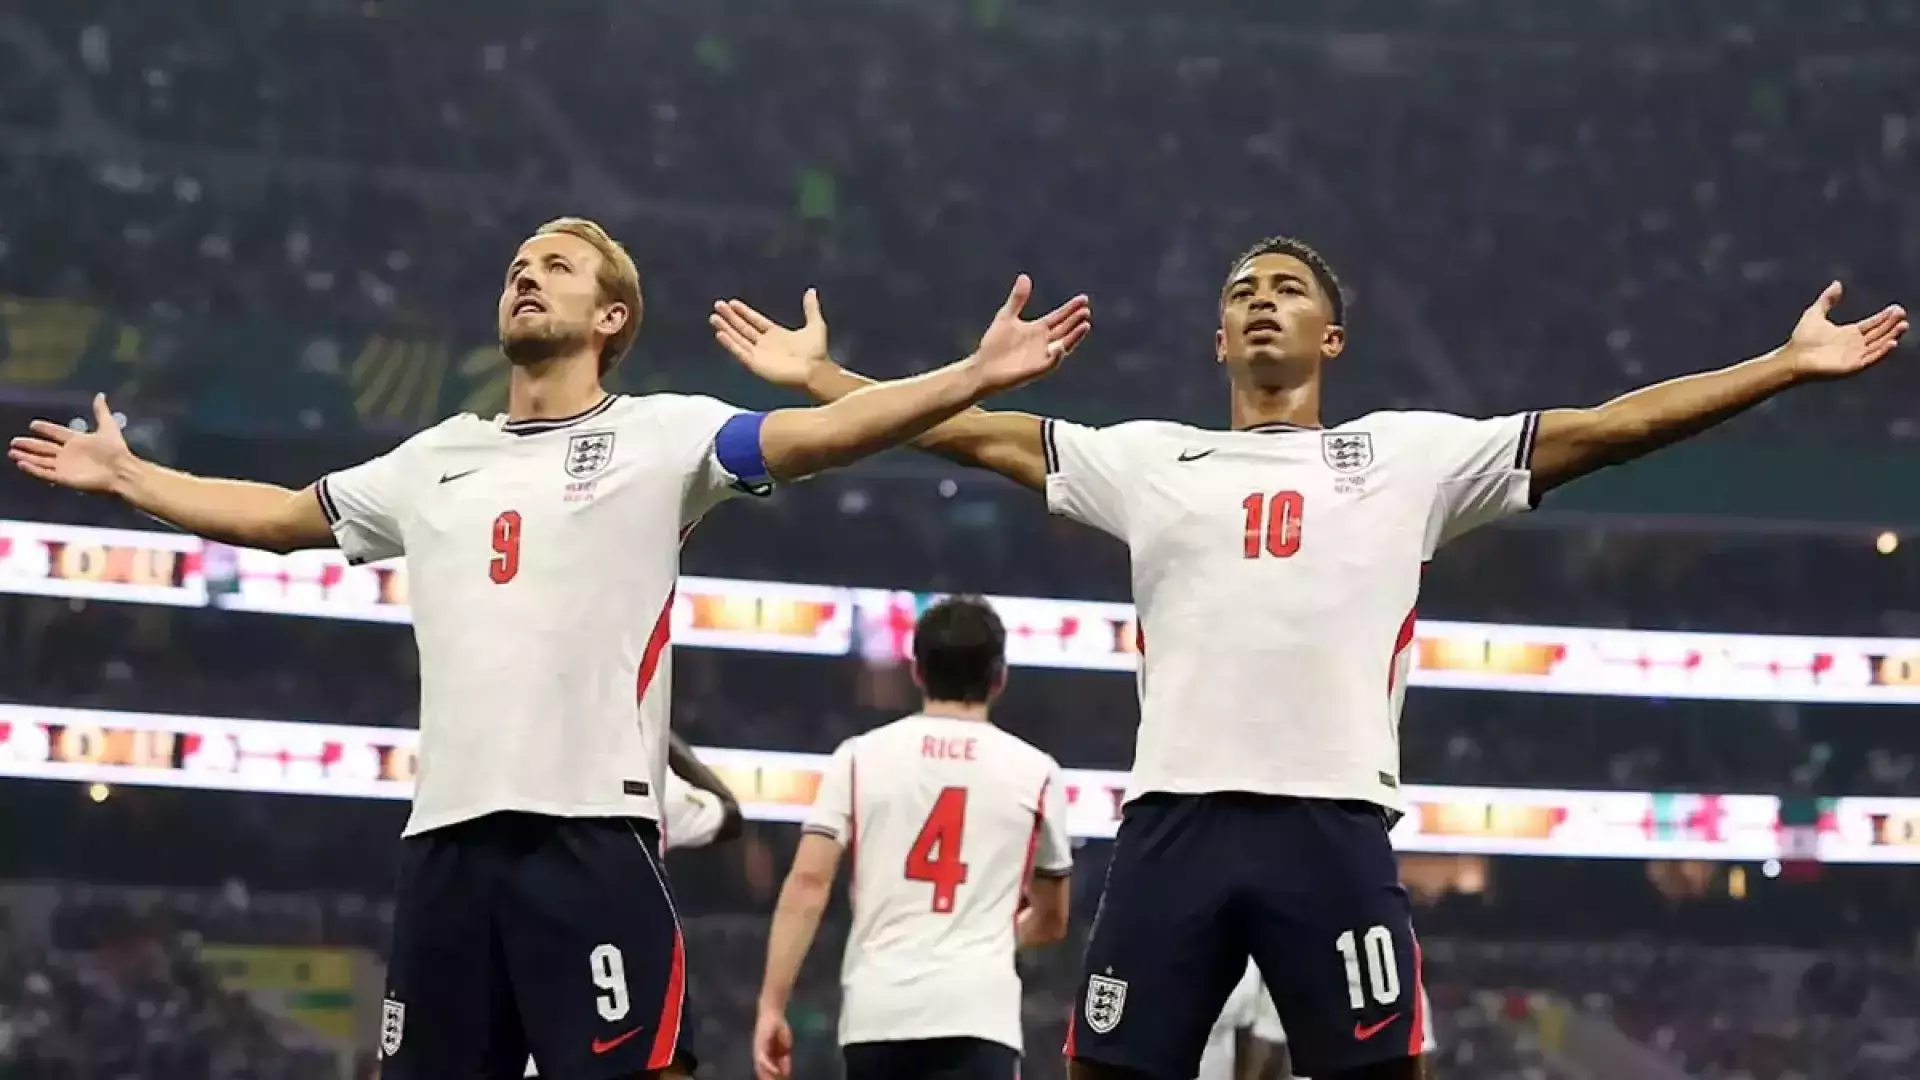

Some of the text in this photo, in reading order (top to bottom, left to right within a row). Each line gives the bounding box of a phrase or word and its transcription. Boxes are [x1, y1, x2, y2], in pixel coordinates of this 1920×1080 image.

[489, 510, 522, 584] 9
[1242, 491, 1304, 559] 10
[921, 735, 978, 761] RICE
[904, 786, 968, 913] 4
[589, 943, 630, 1022] 9
[1336, 925, 1400, 1009] 10
